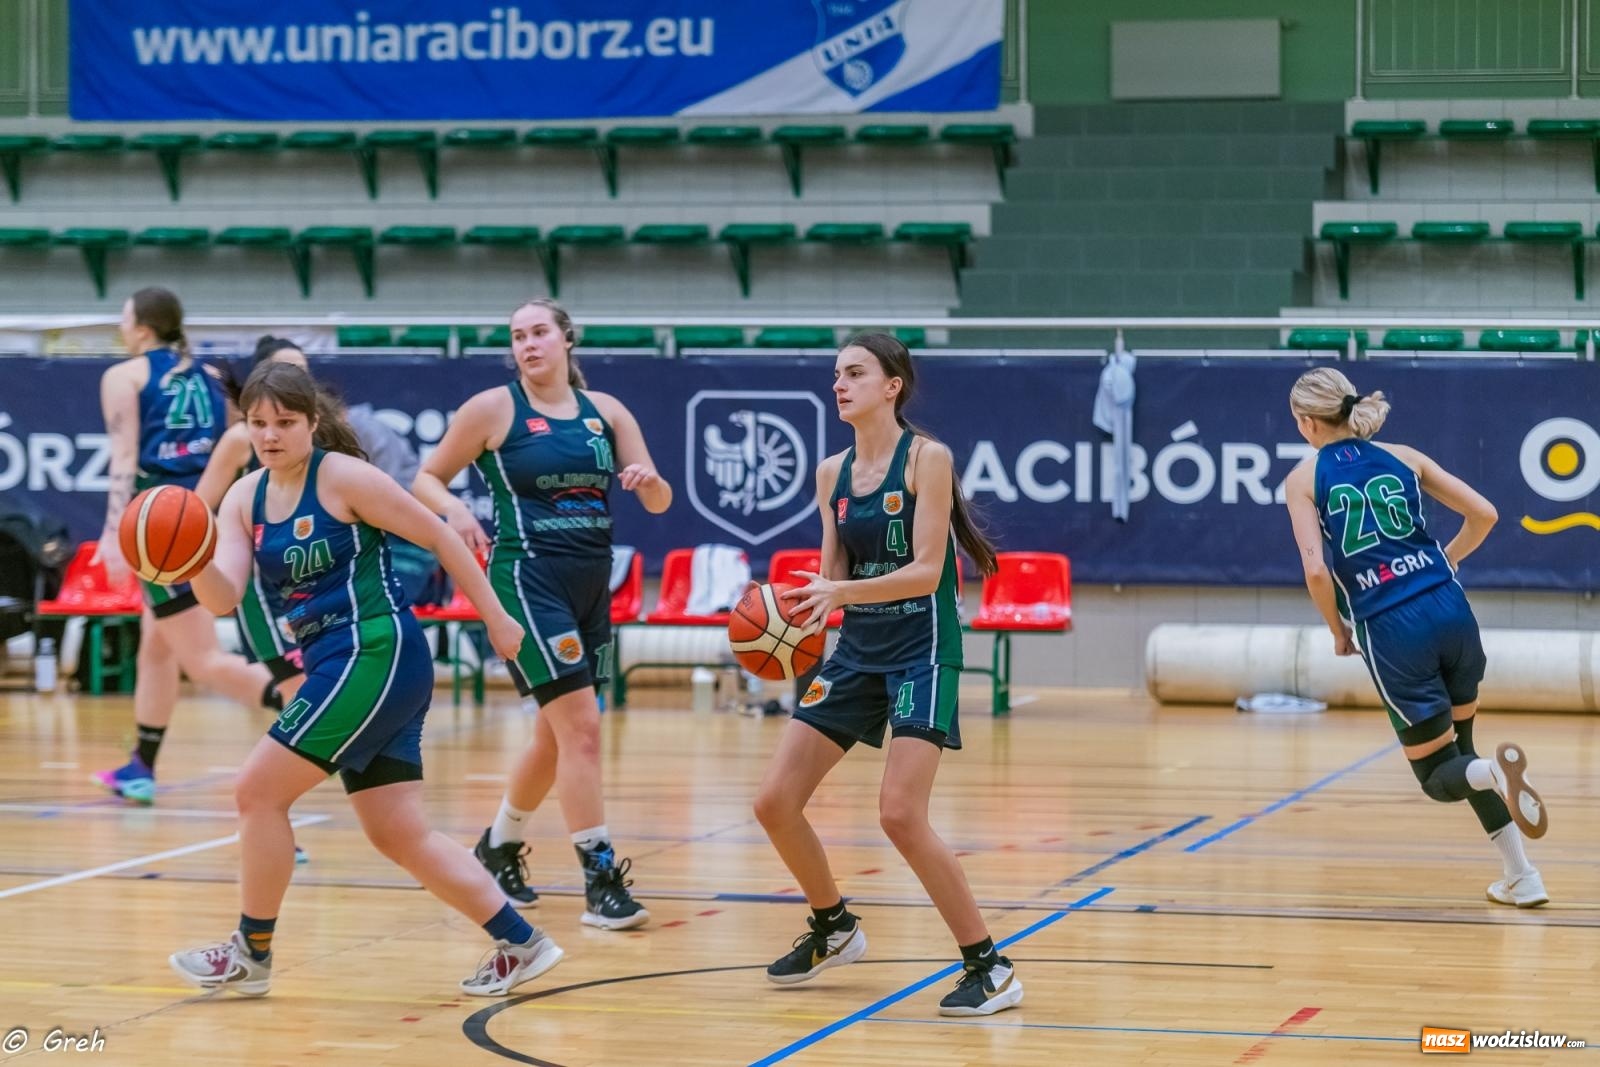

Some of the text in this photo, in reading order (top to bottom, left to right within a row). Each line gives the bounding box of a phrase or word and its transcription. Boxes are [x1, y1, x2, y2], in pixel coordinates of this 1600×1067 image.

[132, 8, 715, 65] www.uniaraciborz.eu
[1327, 473, 1416, 559] 26
[886, 519, 909, 557] 4
[283, 538, 336, 584] 24
[1355, 549, 1435, 592] MAGRA
[277, 697, 313, 734] 4
[894, 680, 915, 719] 4
